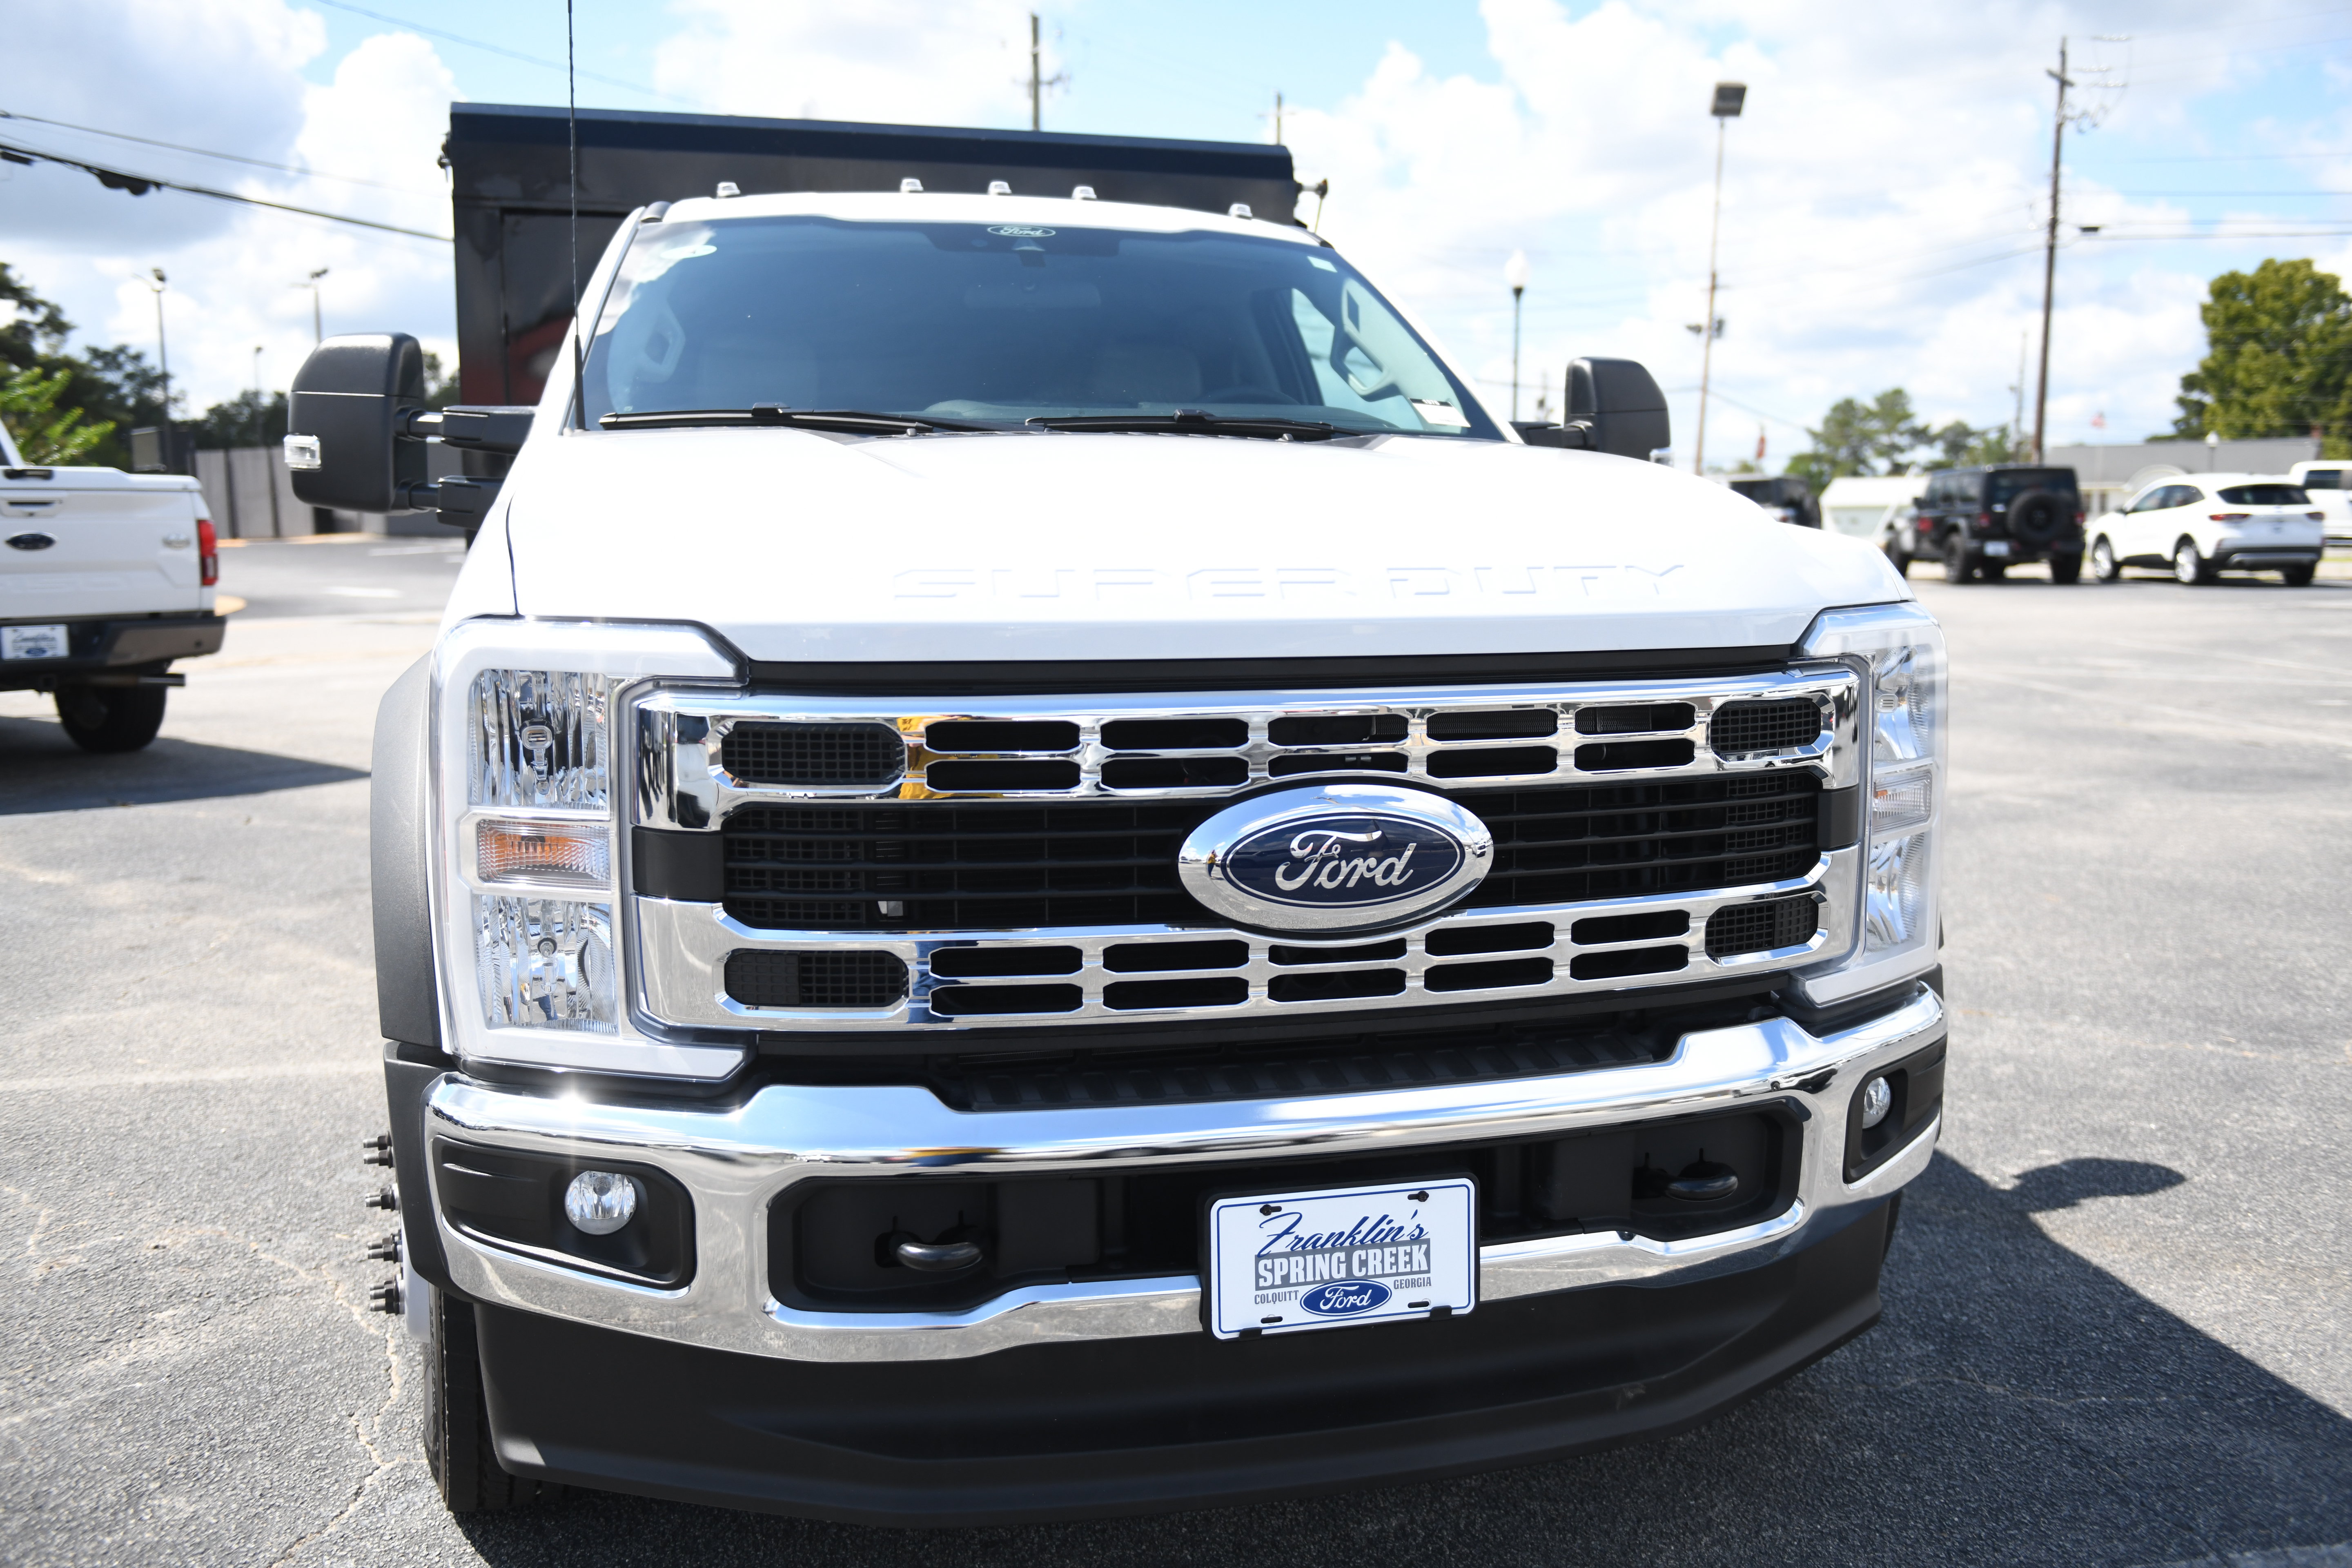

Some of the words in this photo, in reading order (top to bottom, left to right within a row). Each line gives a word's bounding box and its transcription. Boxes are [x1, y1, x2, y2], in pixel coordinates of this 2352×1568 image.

[1000, 226, 1043, 236] Ford
[893, 567, 1357, 600] SUPER
[1387, 565, 1684, 599] DUTY
[1275, 830, 1417, 891] Ford
[1257, 1209, 1428, 1258] Franklin's
[1258, 1252, 1347, 1287] SPRING
[1352, 1244, 1428, 1277] CREEK
[1254, 1290, 1299, 1305] COLQUITT
[1319, 1285, 1372, 1310] Ford
[1394, 1276, 1432, 1290] GEORGIA
